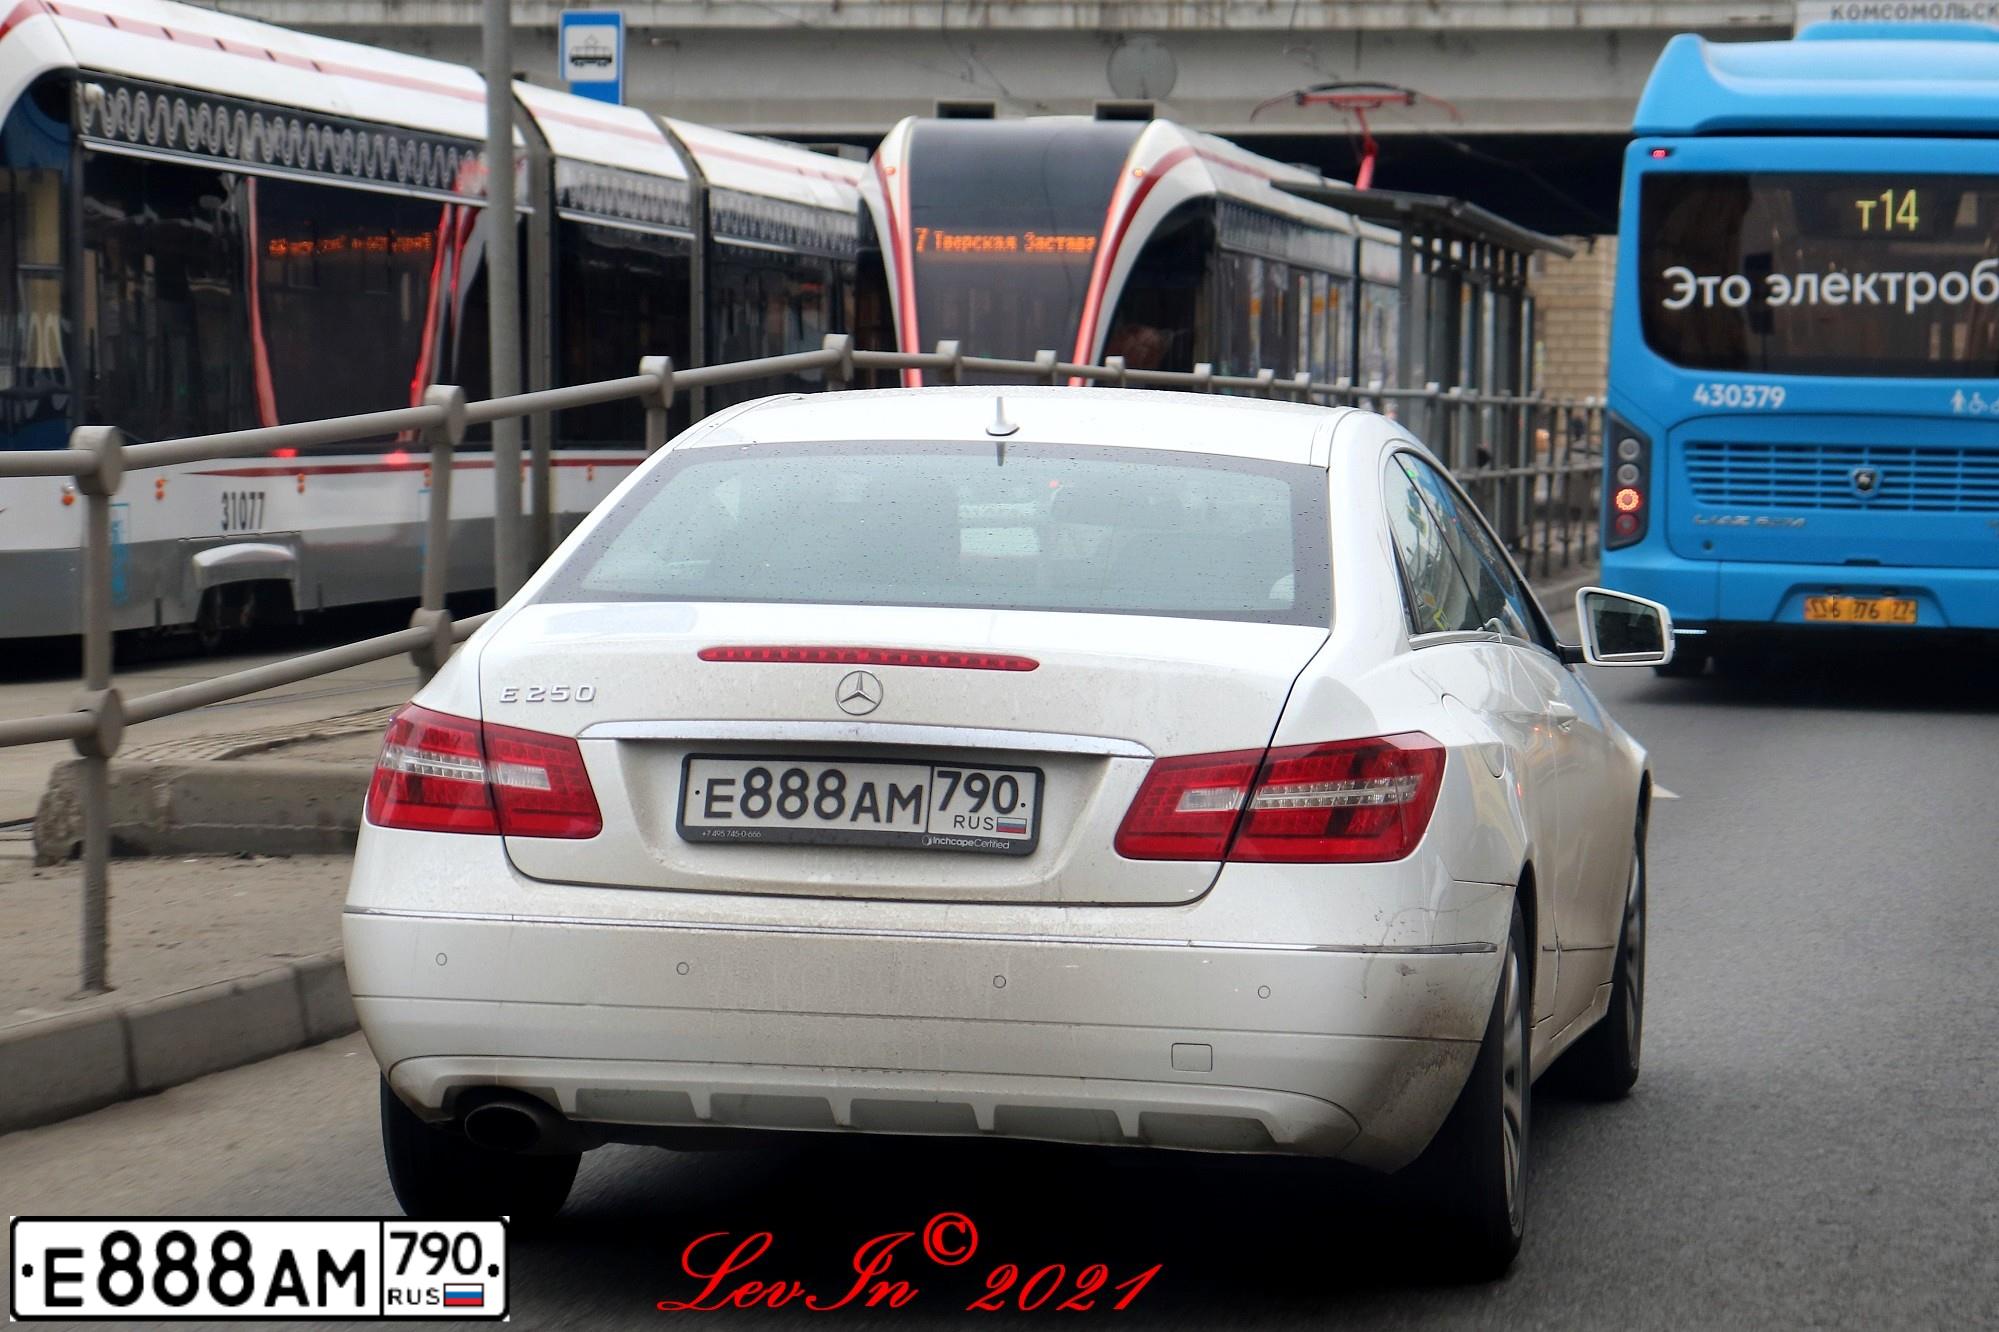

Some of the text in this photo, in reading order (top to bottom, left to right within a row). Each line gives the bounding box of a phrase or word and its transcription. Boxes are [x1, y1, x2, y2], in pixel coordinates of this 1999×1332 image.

[914, 227, 929, 252] 7
[1662, 258, 1999, 314] Это электроб
[1693, 384, 1786, 409] 430379
[221, 491, 265, 531] 31077
[499, 684, 597, 703] E 250
[703, 766, 924, 825] Е888АМ
[936, 770, 1019, 814] 790
[953, 815, 994, 831] RUS
